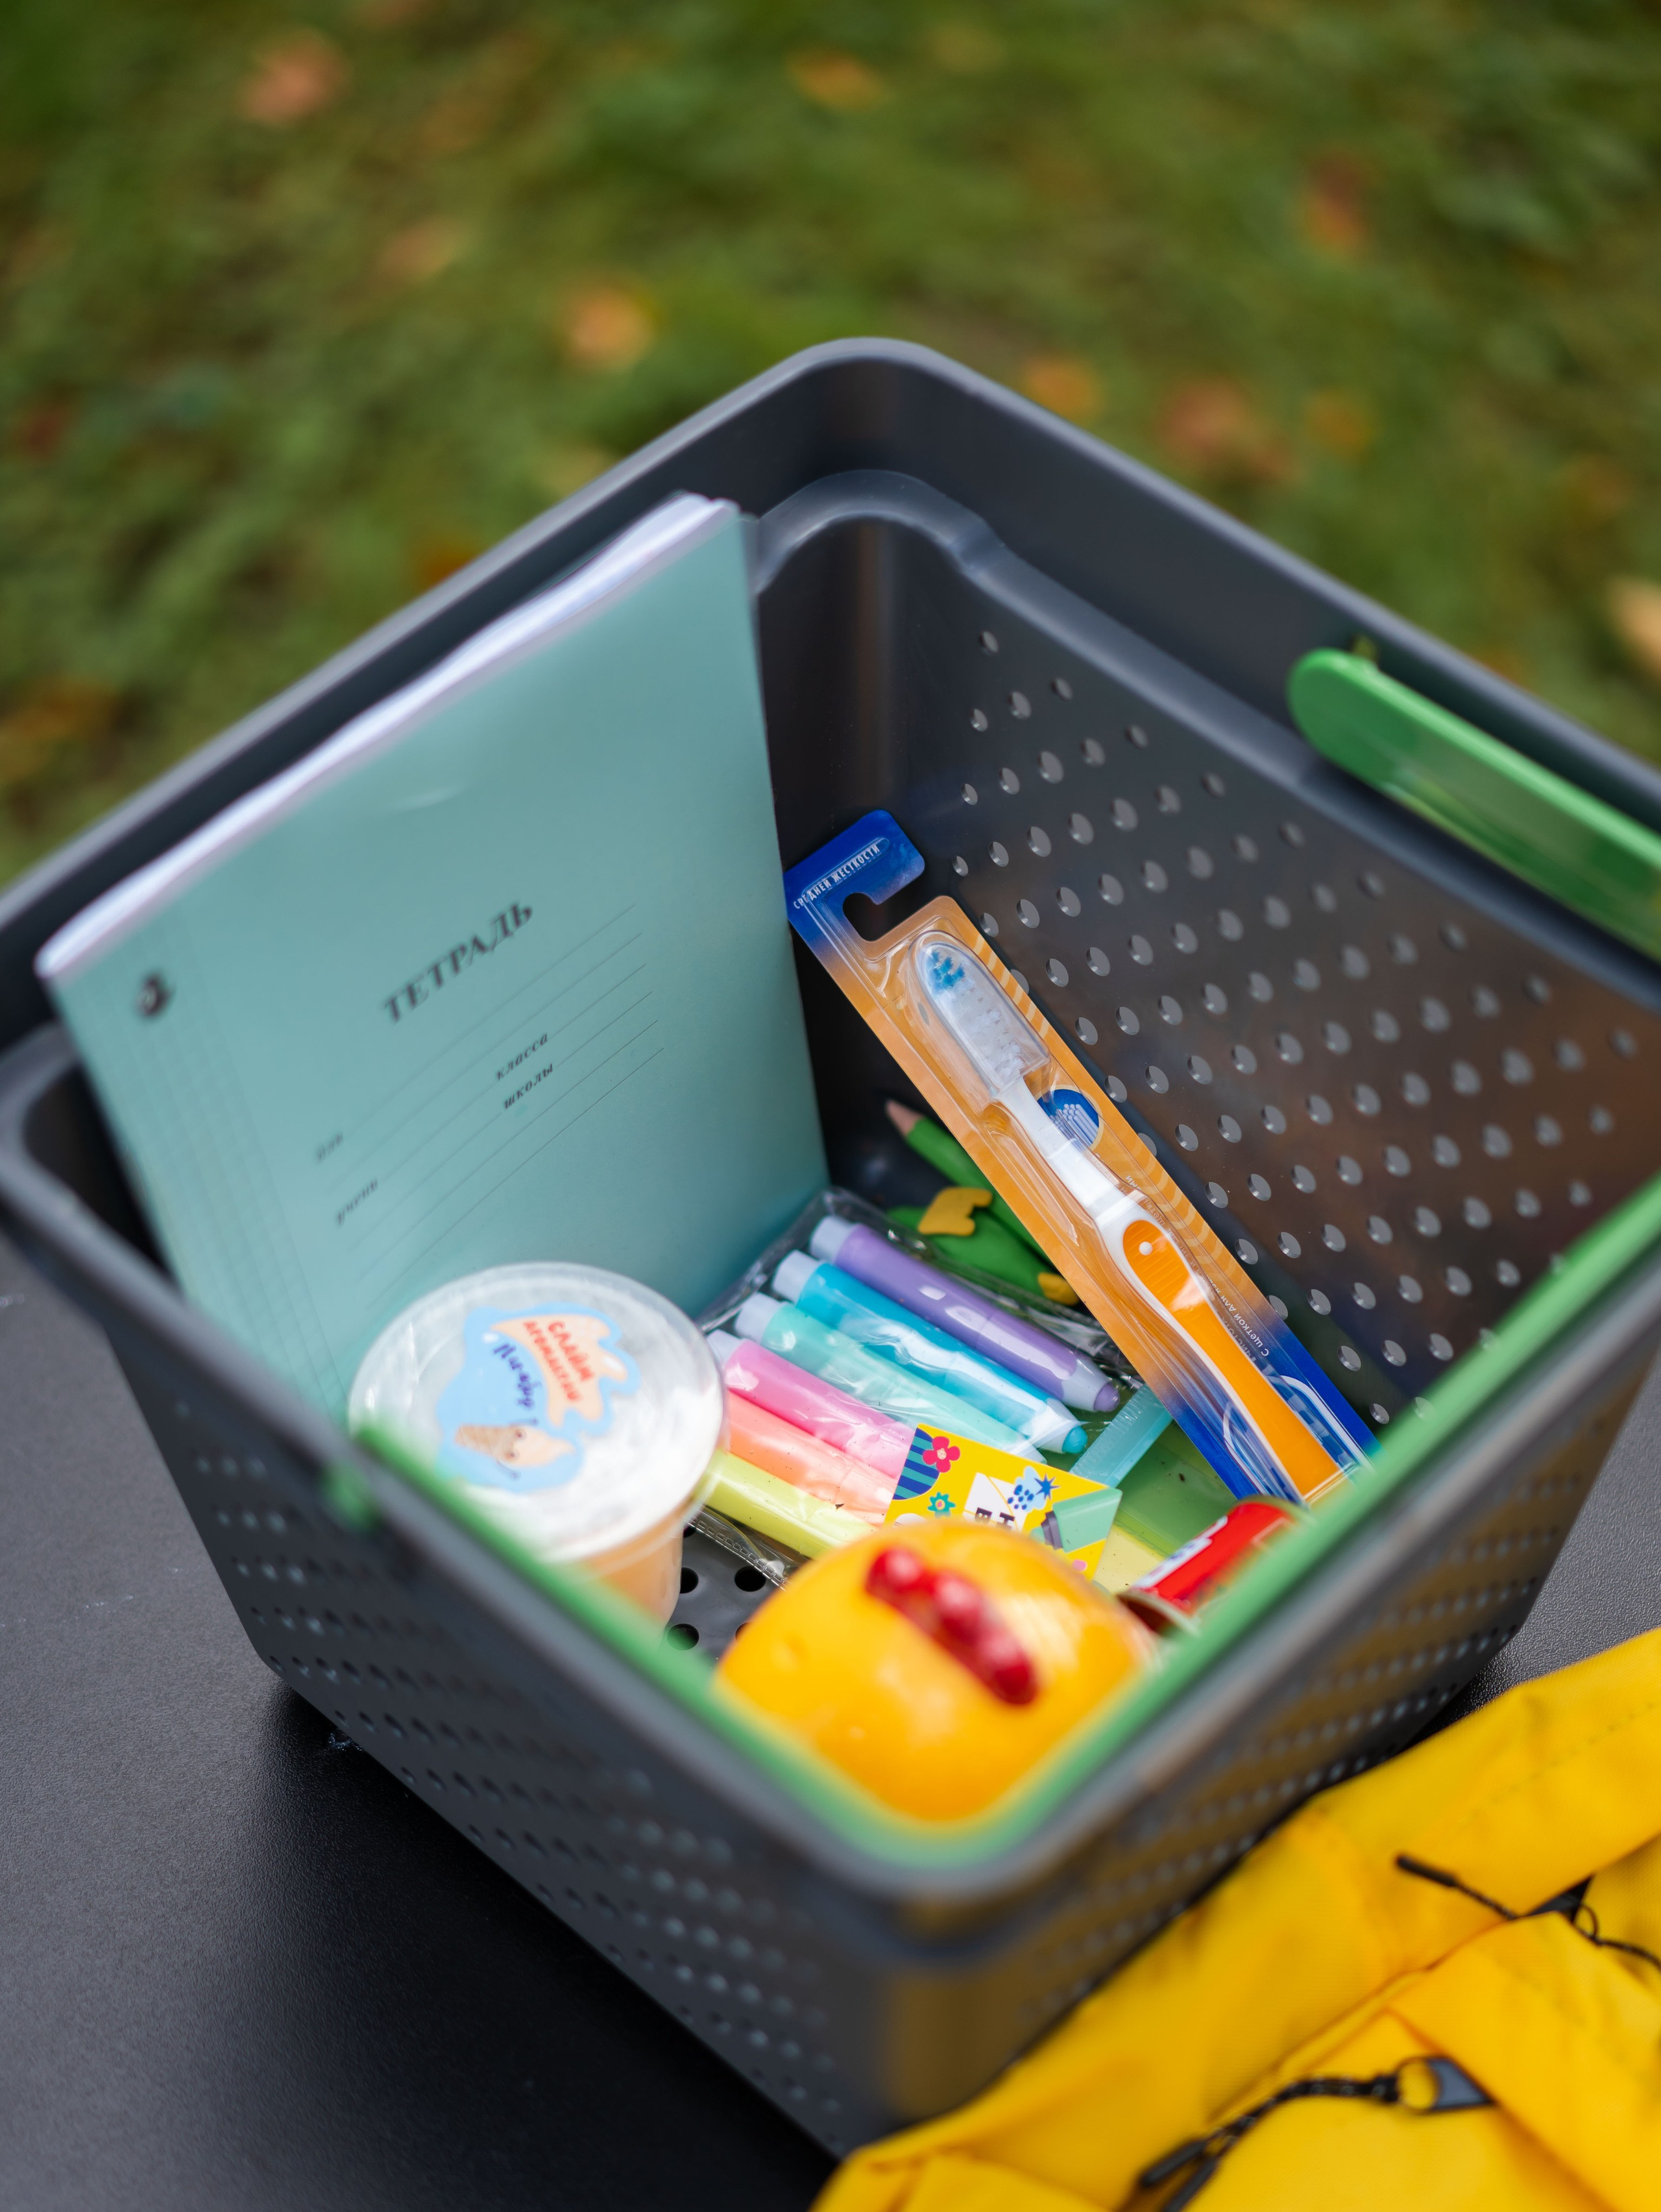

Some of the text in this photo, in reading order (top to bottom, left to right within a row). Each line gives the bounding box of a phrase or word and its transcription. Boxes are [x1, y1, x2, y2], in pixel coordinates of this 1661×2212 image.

[831, 844, 880, 884] ЖЕСТКОСТИ
[382, 902, 534, 1026] ТЕТРАДЬ
[495, 1033, 549, 1082] класса
[503, 1063, 554, 1111] школы
[1220, 1295, 1237, 1313] для
[548, 1321, 595, 1382] СЛАЙМ
